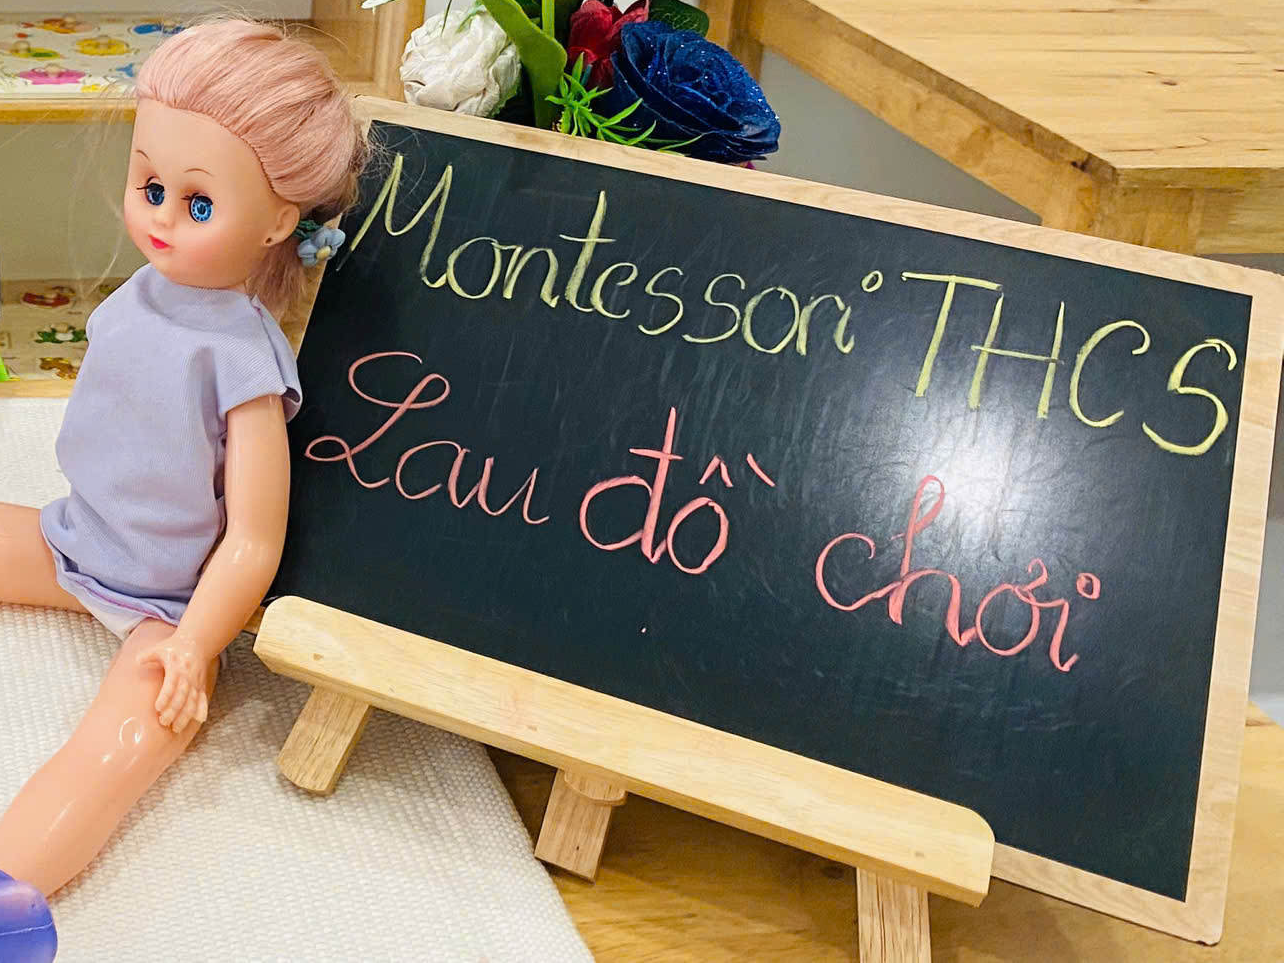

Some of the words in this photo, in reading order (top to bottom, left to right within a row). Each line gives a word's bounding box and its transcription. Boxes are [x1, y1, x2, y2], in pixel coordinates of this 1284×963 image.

[346, 152, 884, 356] Montessori
[901, 271, 1238, 456] THCS
[305, 351, 550, 525] Lau
[579, 406, 777, 575] đồ
[815, 475, 1102, 673] chơi
